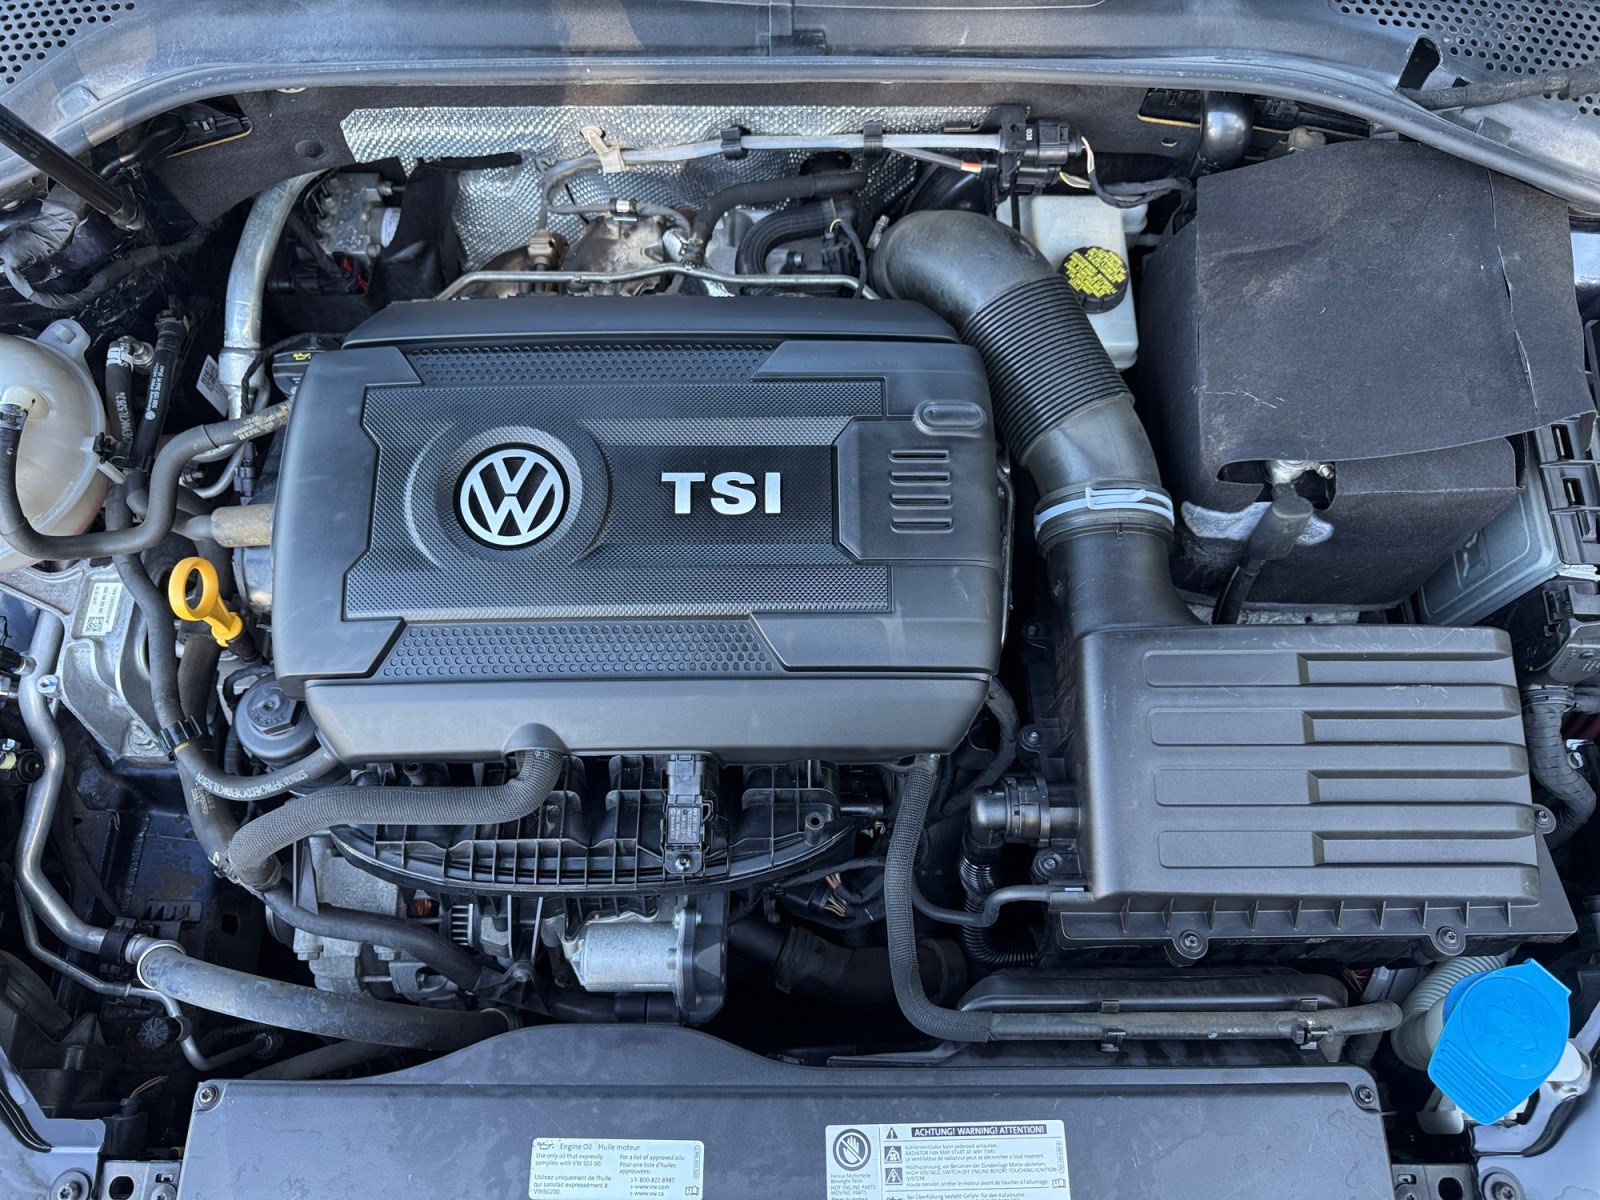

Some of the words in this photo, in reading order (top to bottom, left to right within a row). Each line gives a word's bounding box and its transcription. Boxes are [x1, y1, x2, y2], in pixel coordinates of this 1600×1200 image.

[661, 471, 782, 515] TSI
[914, 1128, 956, 1136] ACHTUNG!
[958, 1127, 998, 1136] WARNING!
[1000, 1126, 1044, 1134] ATTENTION!
